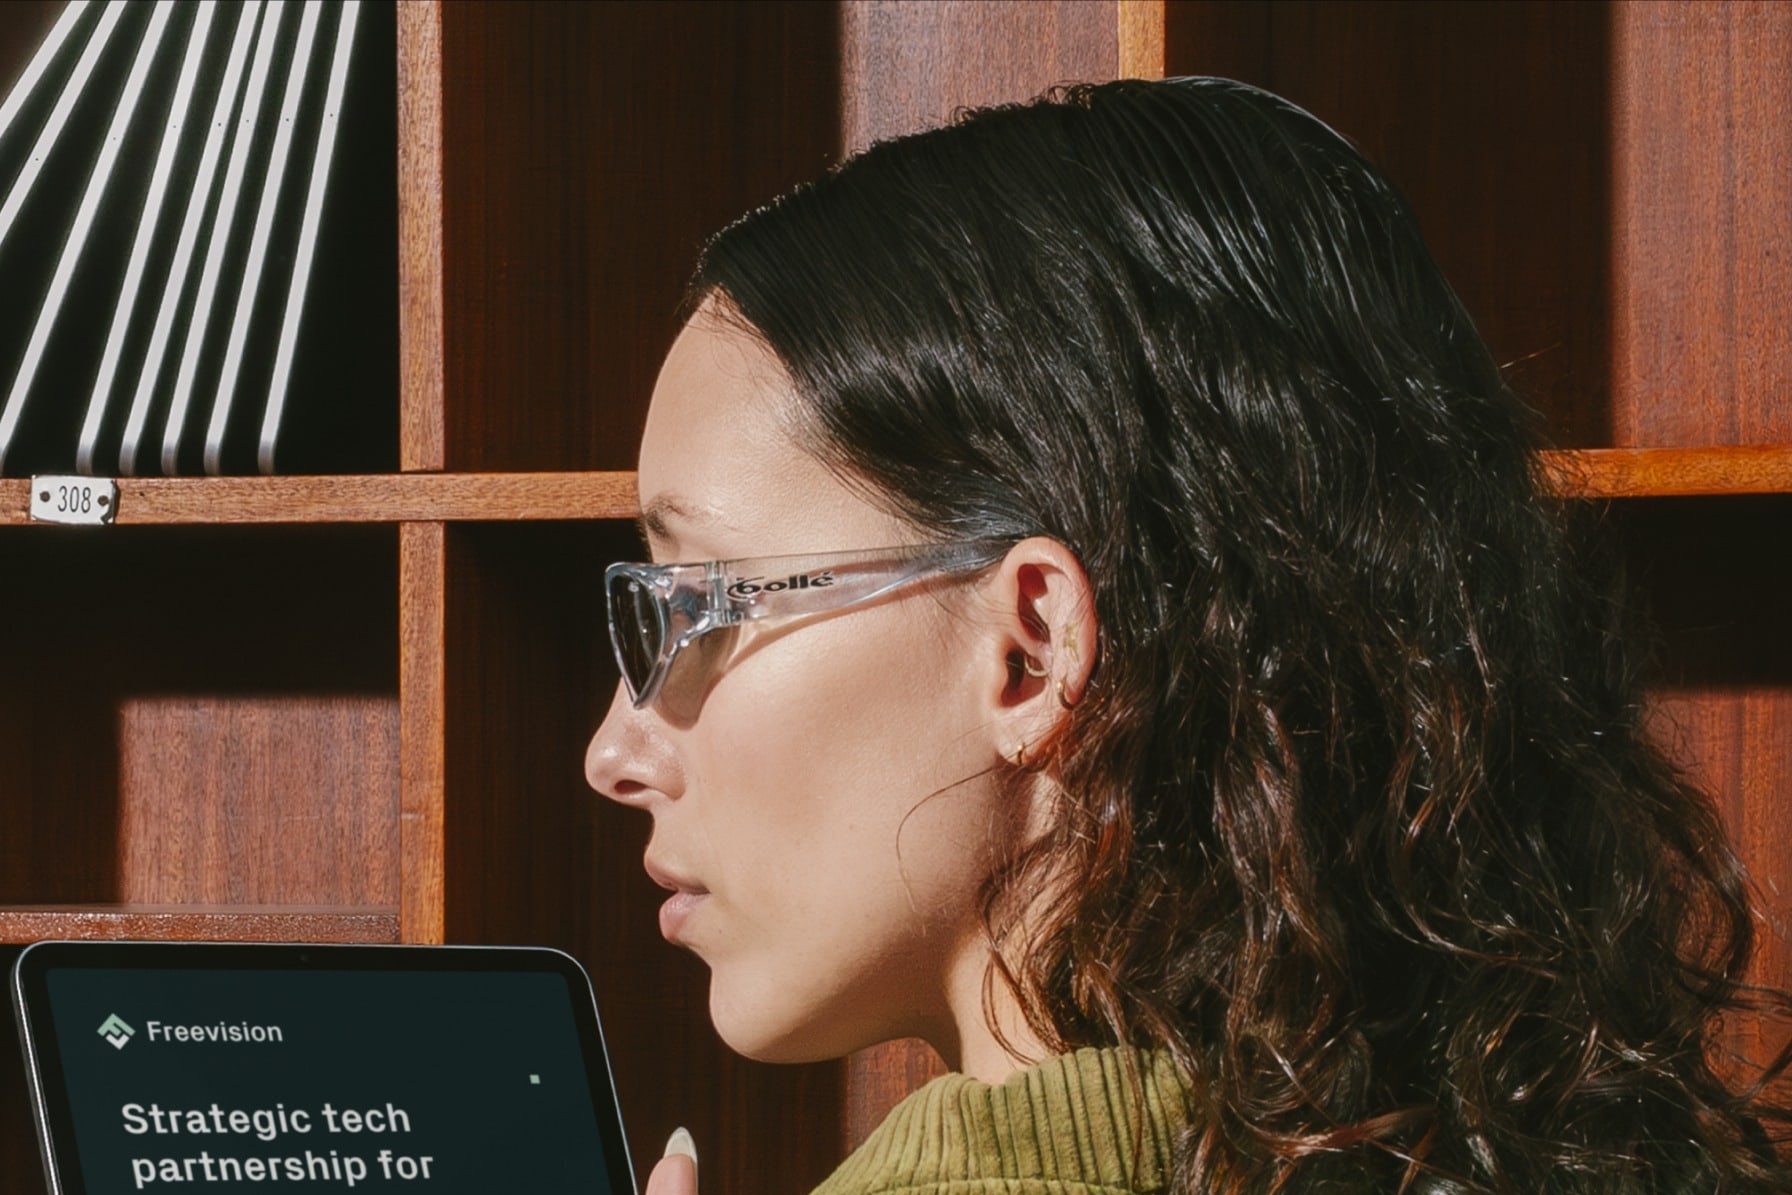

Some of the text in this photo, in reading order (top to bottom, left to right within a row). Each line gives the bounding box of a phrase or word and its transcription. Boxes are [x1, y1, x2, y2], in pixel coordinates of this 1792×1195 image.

[57, 485, 92, 514] 308
[146, 1021, 284, 1043] Freevision
[121, 1103, 411, 1142] Strategic tech
[132, 1150, 434, 1189] partnership for
